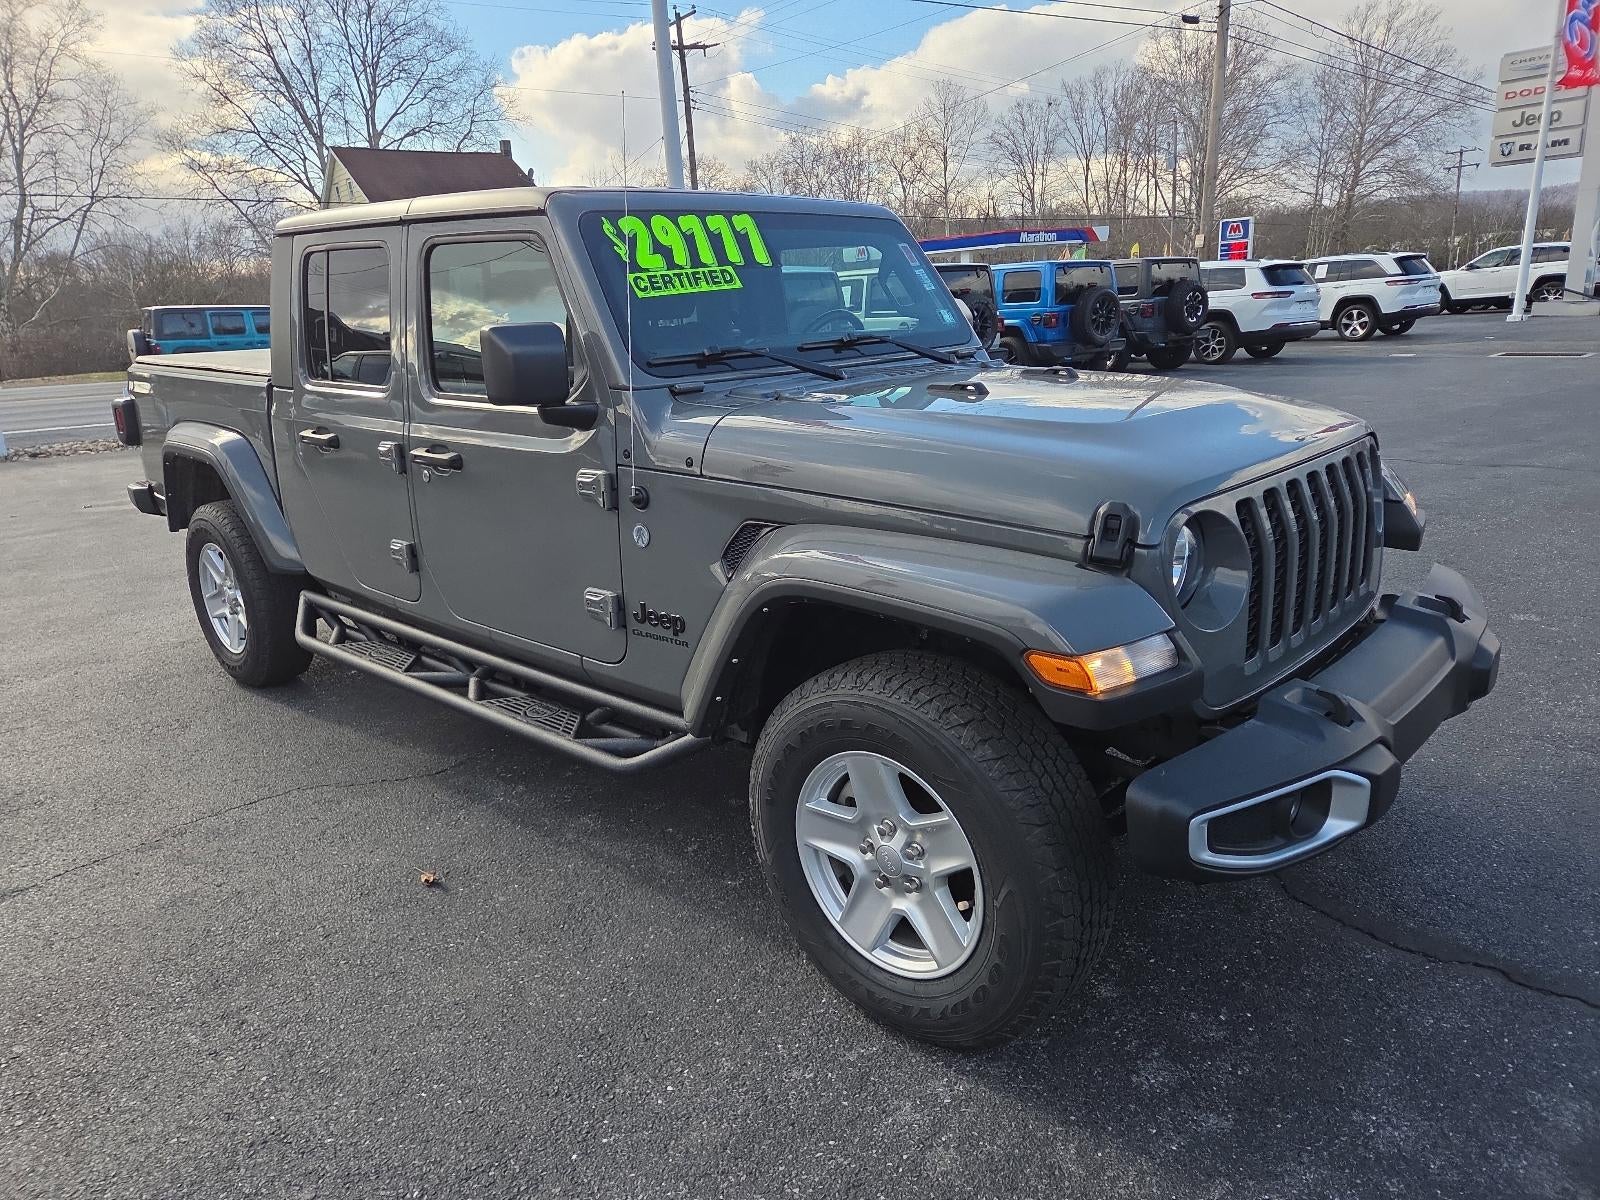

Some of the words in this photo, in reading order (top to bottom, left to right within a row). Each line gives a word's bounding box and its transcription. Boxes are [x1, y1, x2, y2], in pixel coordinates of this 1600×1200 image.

[1019, 231, 1057, 243] Marathon
[631, 268, 736, 293] CERTIFIED
[632, 600, 686, 637] Jeep
[631, 628, 690, 649] GLADIATOR
